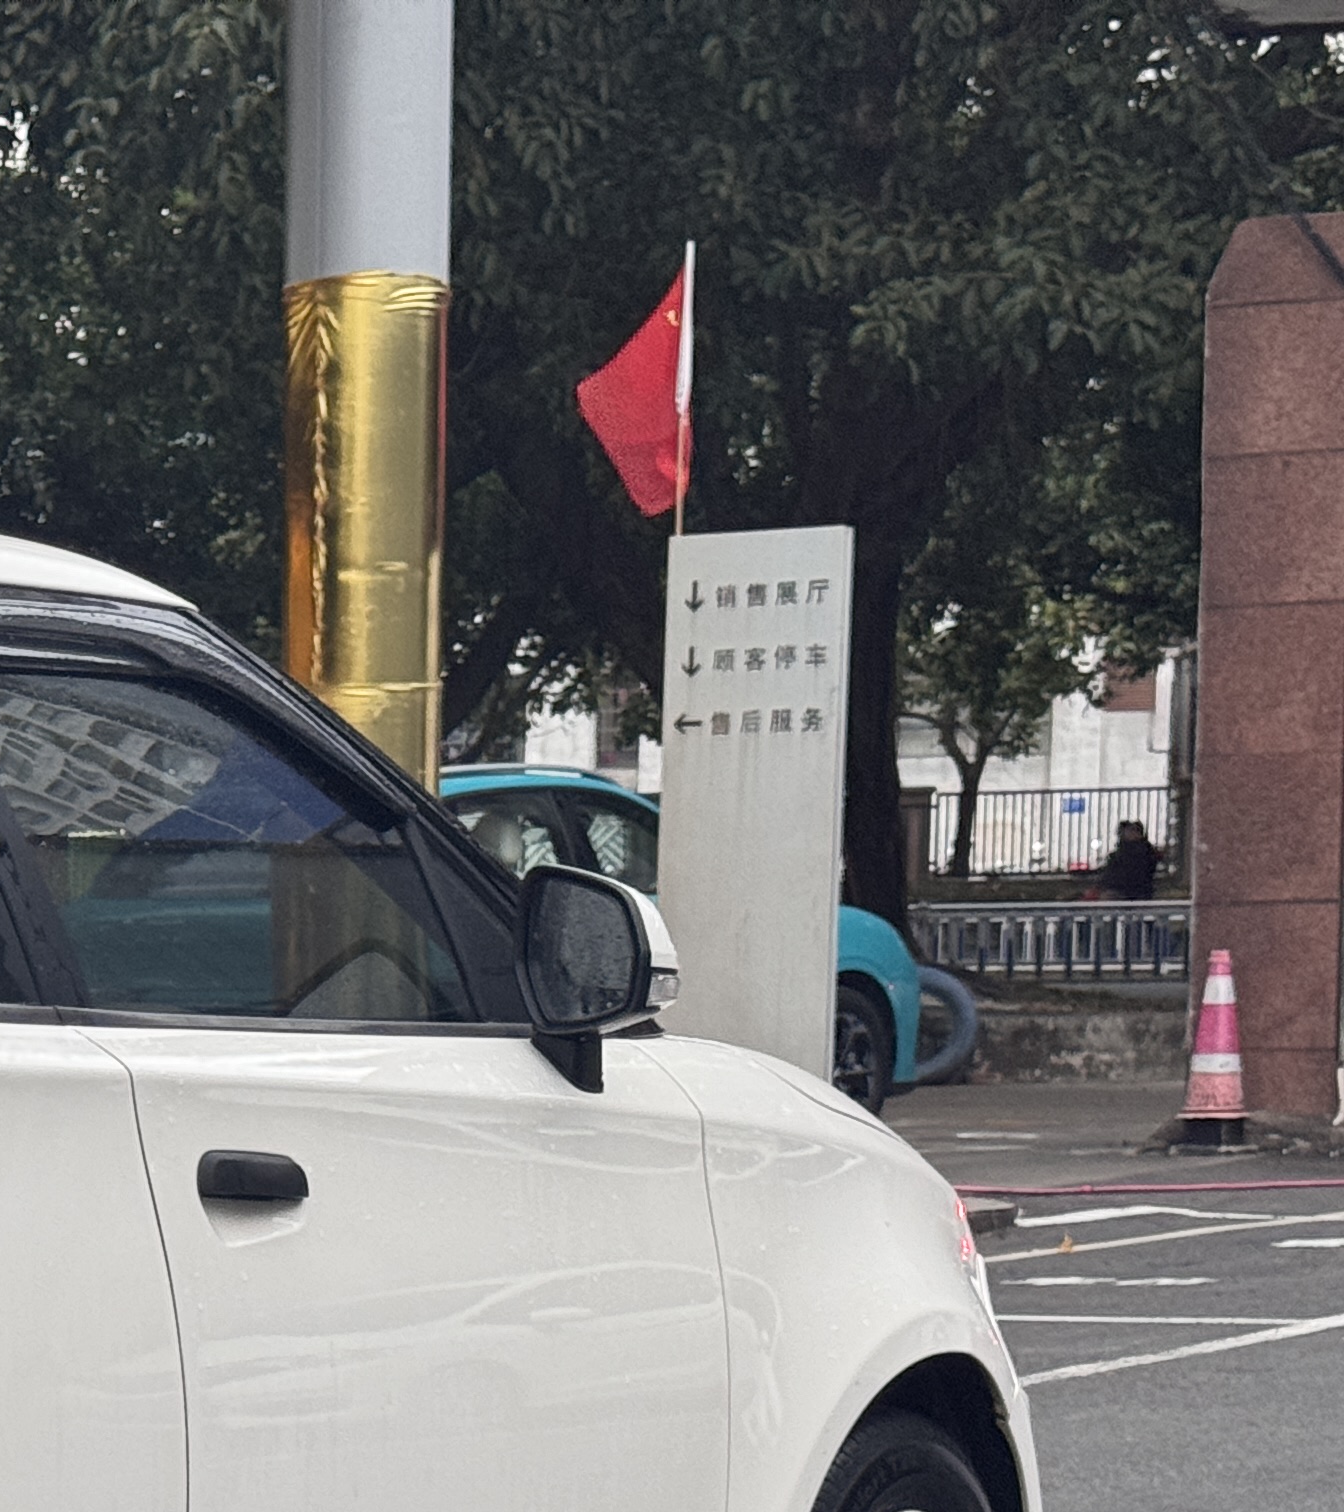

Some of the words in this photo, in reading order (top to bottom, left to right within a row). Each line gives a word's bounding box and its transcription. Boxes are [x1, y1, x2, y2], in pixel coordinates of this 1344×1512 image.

[715, 578, 829, 608] 销售展厅
[713, 644, 827, 671] 顾客停车
[711, 708, 823, 735] 售后服务
